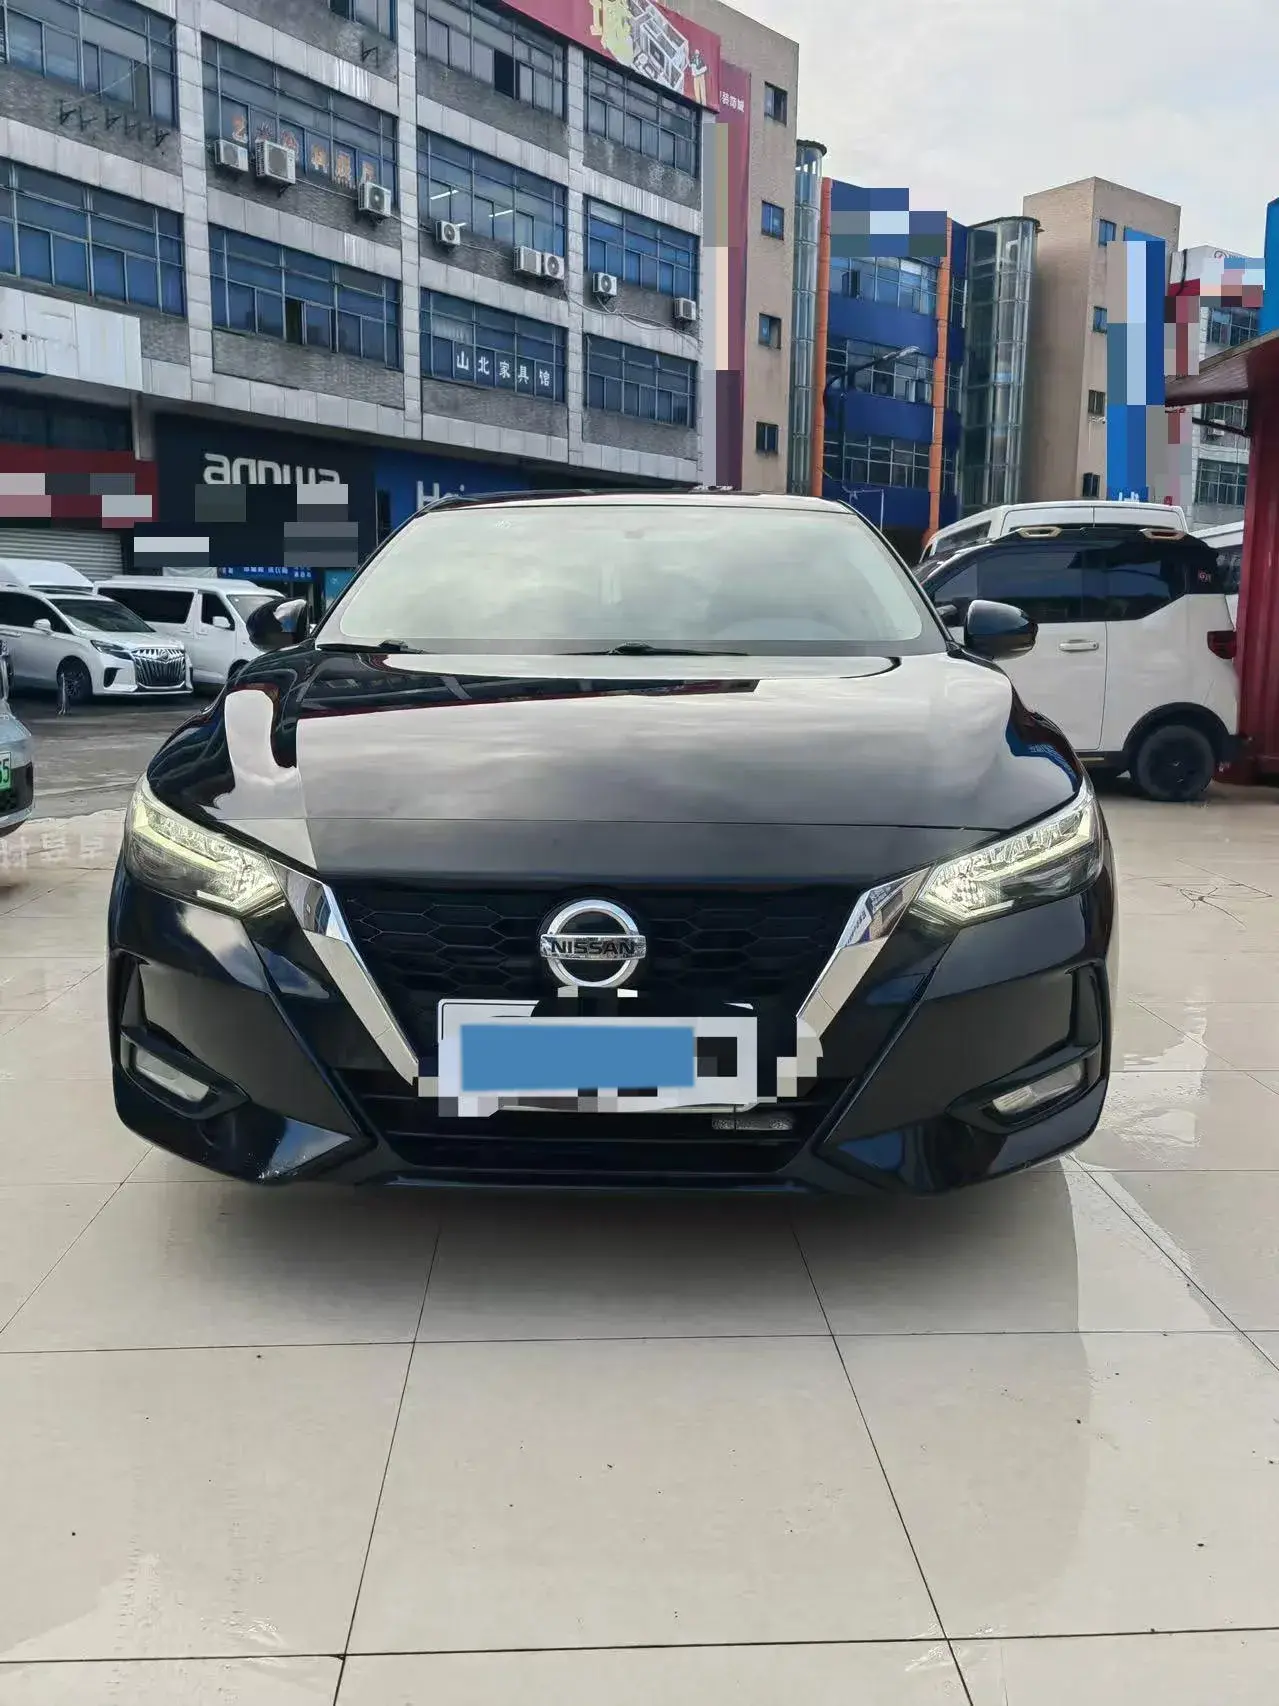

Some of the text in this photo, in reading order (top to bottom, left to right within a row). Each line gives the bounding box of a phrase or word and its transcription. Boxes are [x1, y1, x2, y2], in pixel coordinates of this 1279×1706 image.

[720, 91, 745, 113] 装饰城
[456, 351, 551, 387] 山北家具馆
[551, 940, 635, 955] NISSAN
